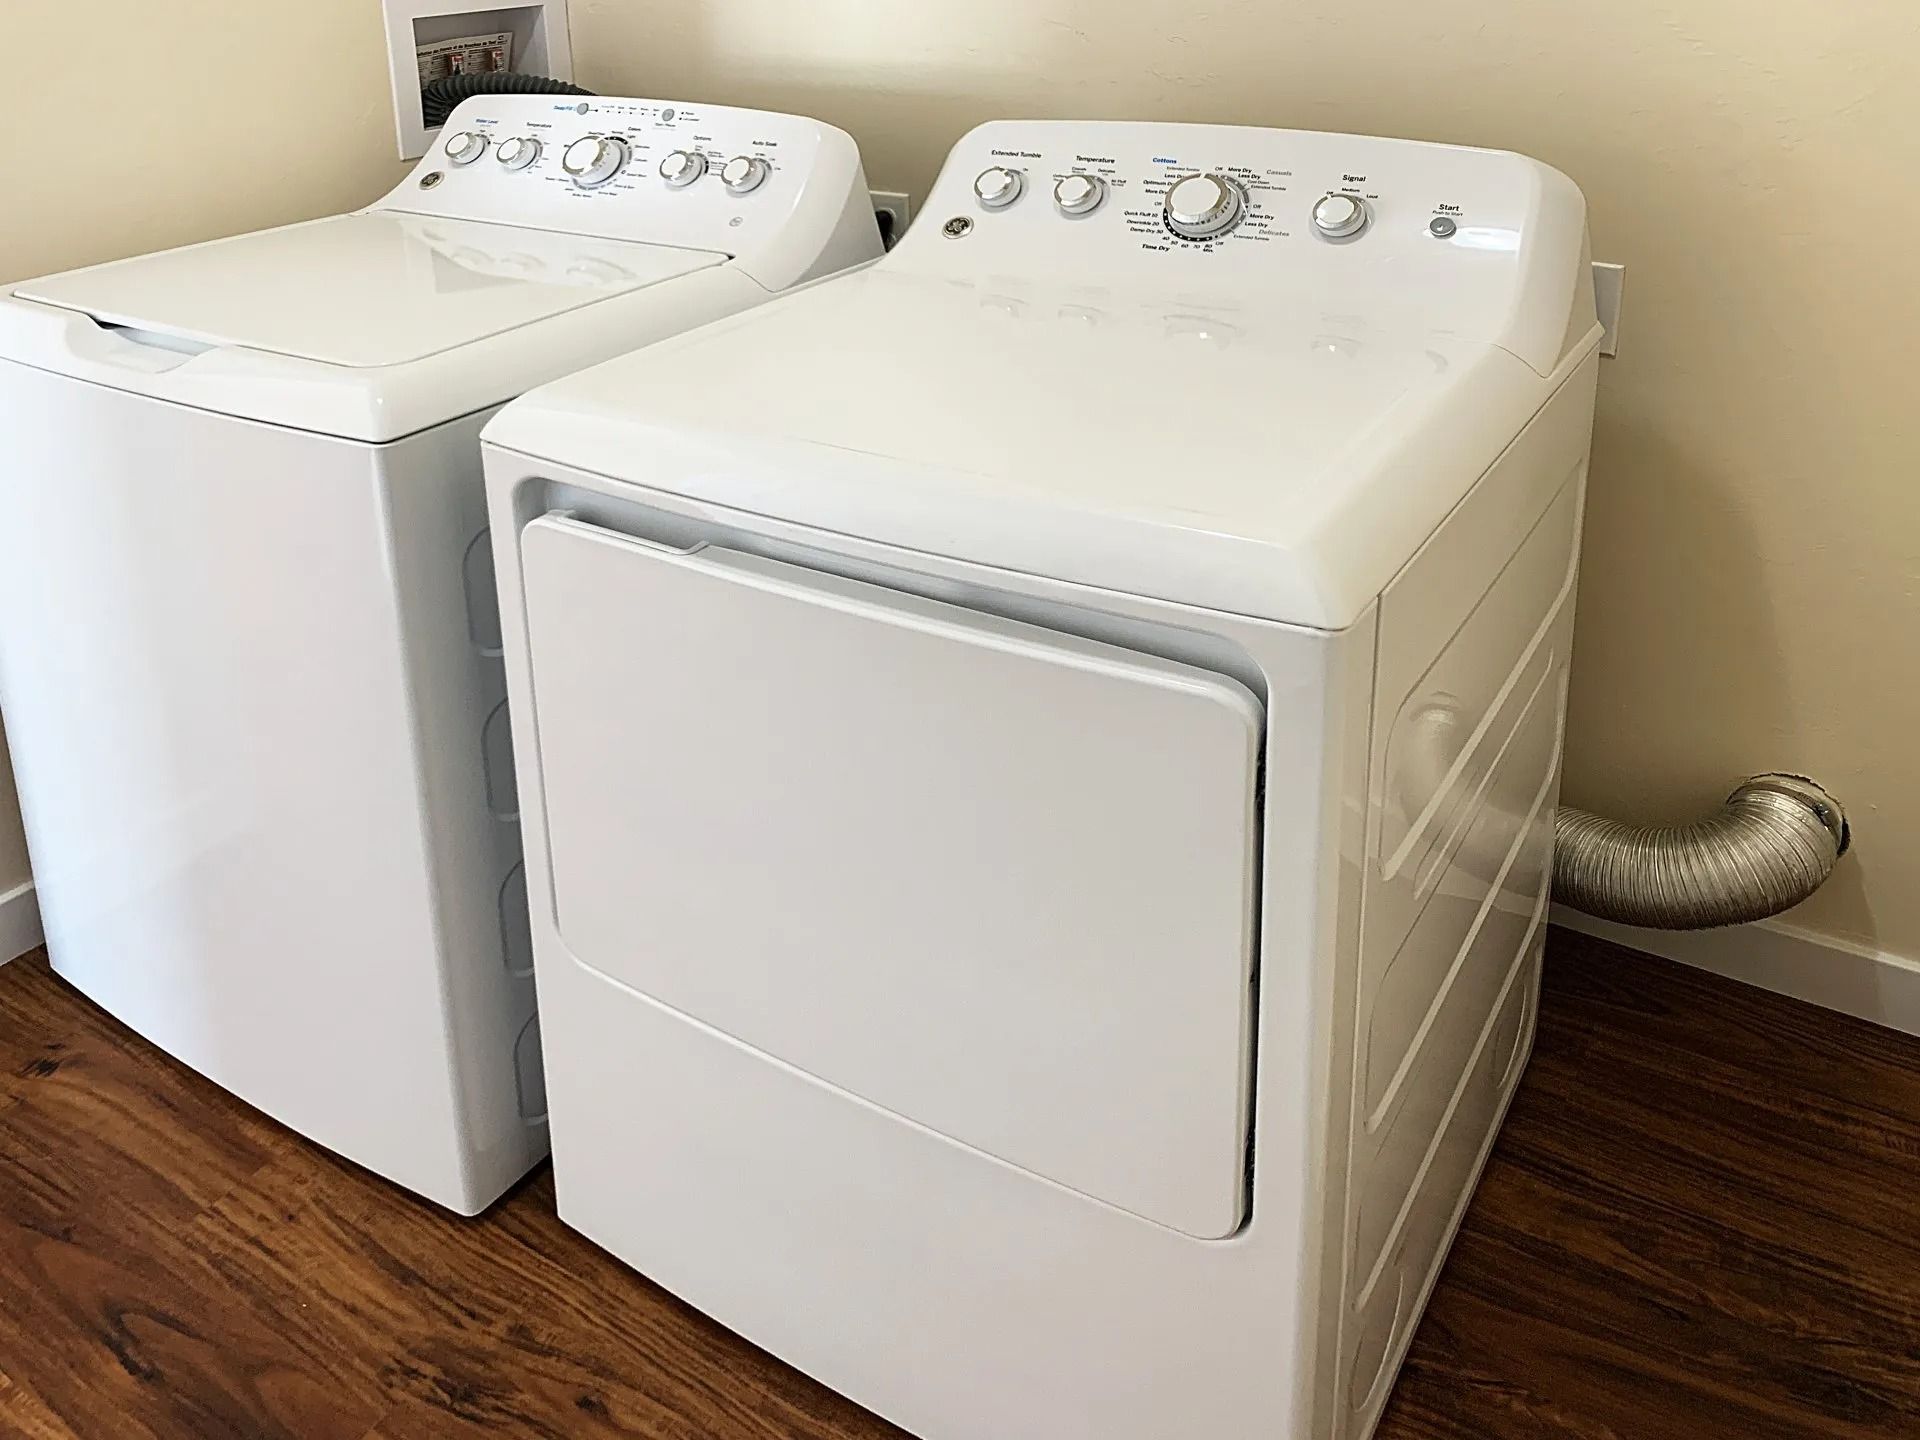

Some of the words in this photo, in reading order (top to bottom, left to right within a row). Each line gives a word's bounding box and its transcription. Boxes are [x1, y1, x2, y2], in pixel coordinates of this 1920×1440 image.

[1076, 155, 1115, 164] Temperature
[1342, 174, 1366, 183] Signal
[1438, 204, 1460, 212] Start
